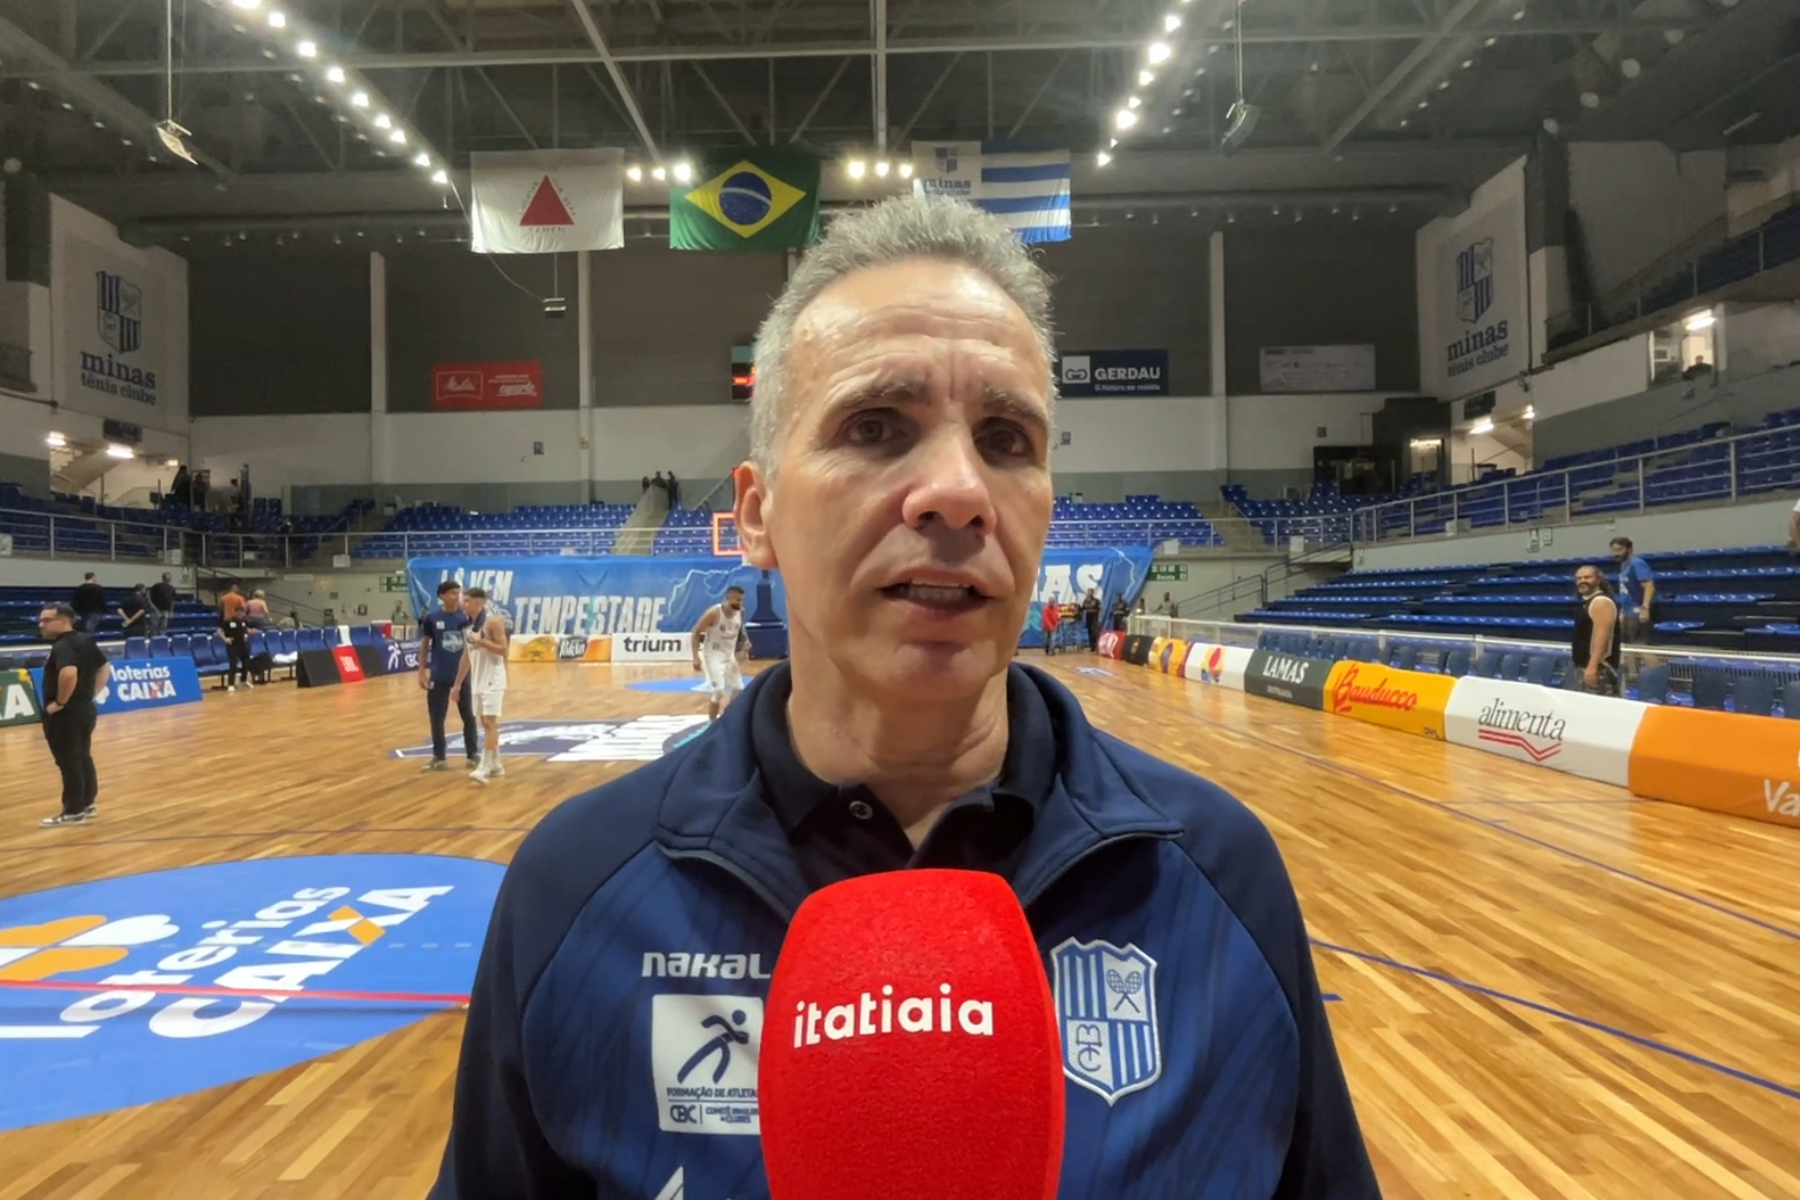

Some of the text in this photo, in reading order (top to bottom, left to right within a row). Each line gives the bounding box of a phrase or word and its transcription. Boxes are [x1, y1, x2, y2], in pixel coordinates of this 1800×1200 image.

[1447, 320, 1508, 362] minas
[80, 351, 156, 390] minas
[1094, 367, 1161, 381] GERDAU
[514, 595, 667, 635] TEMPESTADE
[623, 635, 682, 652] trium
[110, 663, 170, 681] loterias
[1263, 655, 1309, 684] LAMAS
[1333, 663, 1418, 713] Bauducco
[117, 680, 177, 702] CAIXA
[1478, 697, 1566, 742] alimenta
[149, 885, 455, 1038] CAIXA
[794, 983, 994, 1048] itatiaia
[667, 1086, 713, 1100] FORMAÇÃO
[715, 1088, 726, 1098] DE
